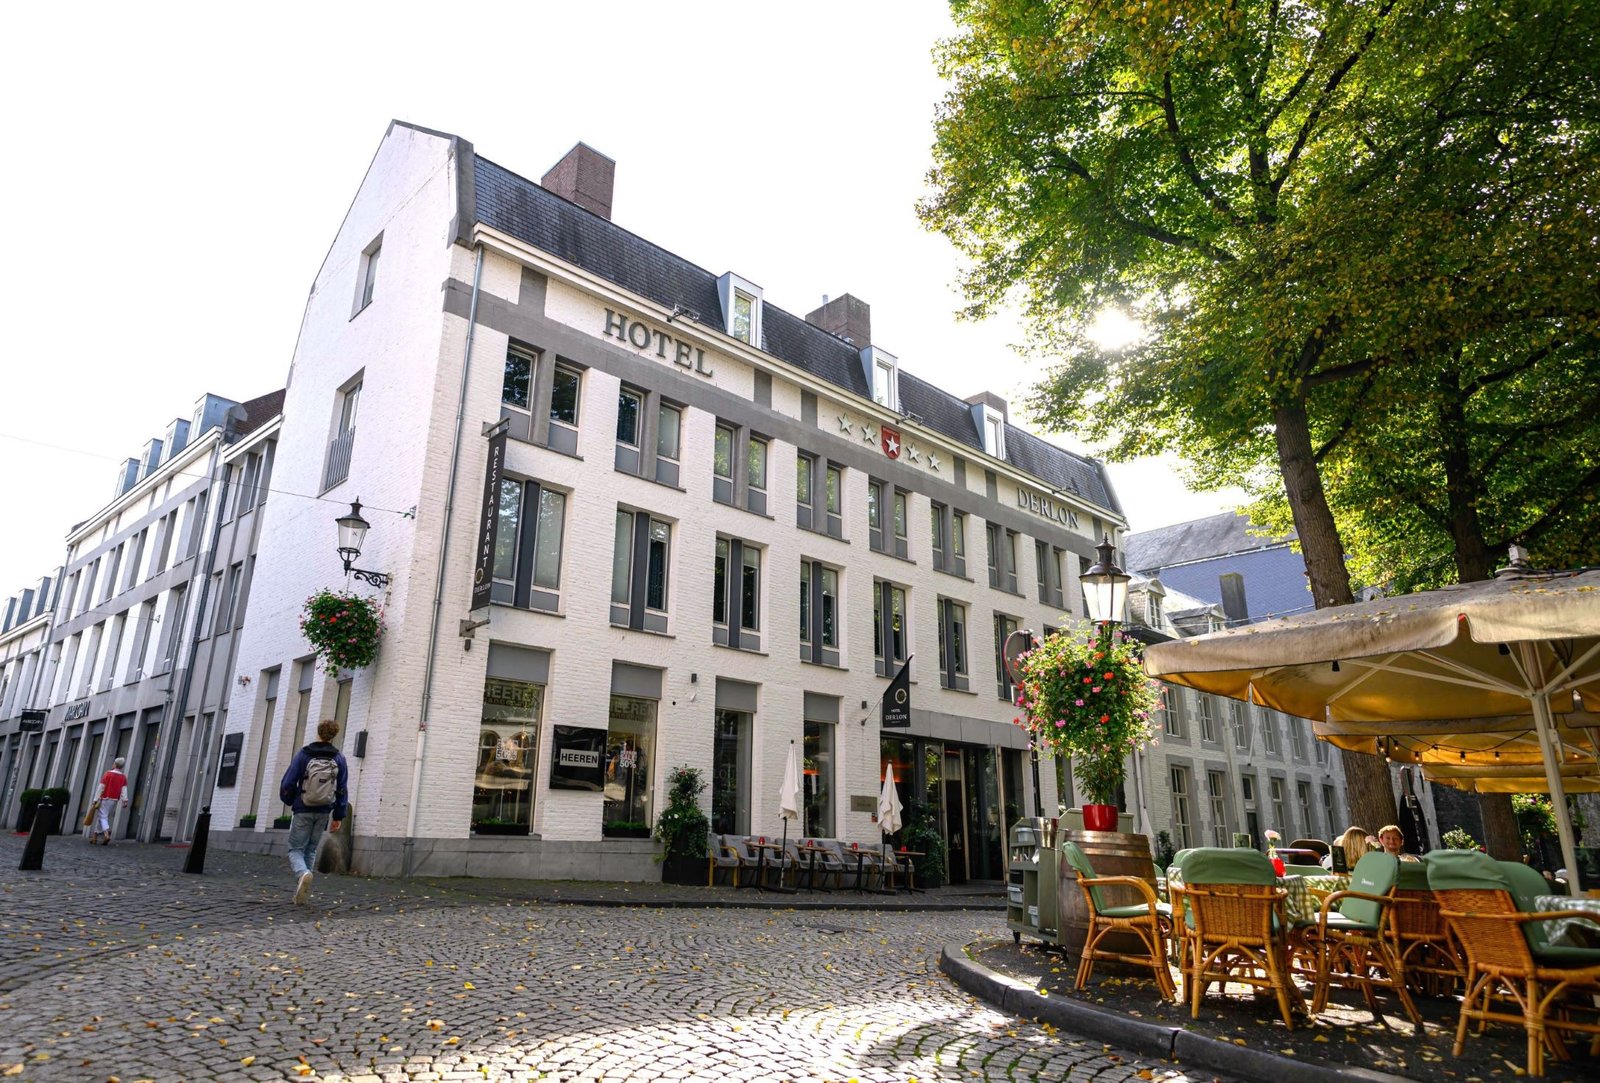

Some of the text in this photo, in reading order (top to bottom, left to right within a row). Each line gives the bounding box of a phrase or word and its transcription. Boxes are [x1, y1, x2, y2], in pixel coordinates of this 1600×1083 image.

[602, 307, 713, 378] HOTEL
[482, 446, 500, 568] RESTAURANT
[1016, 486, 1080, 530] DERLON
[561, 752, 599, 765] HEEREN
[620, 759, 637, 769] 50%
